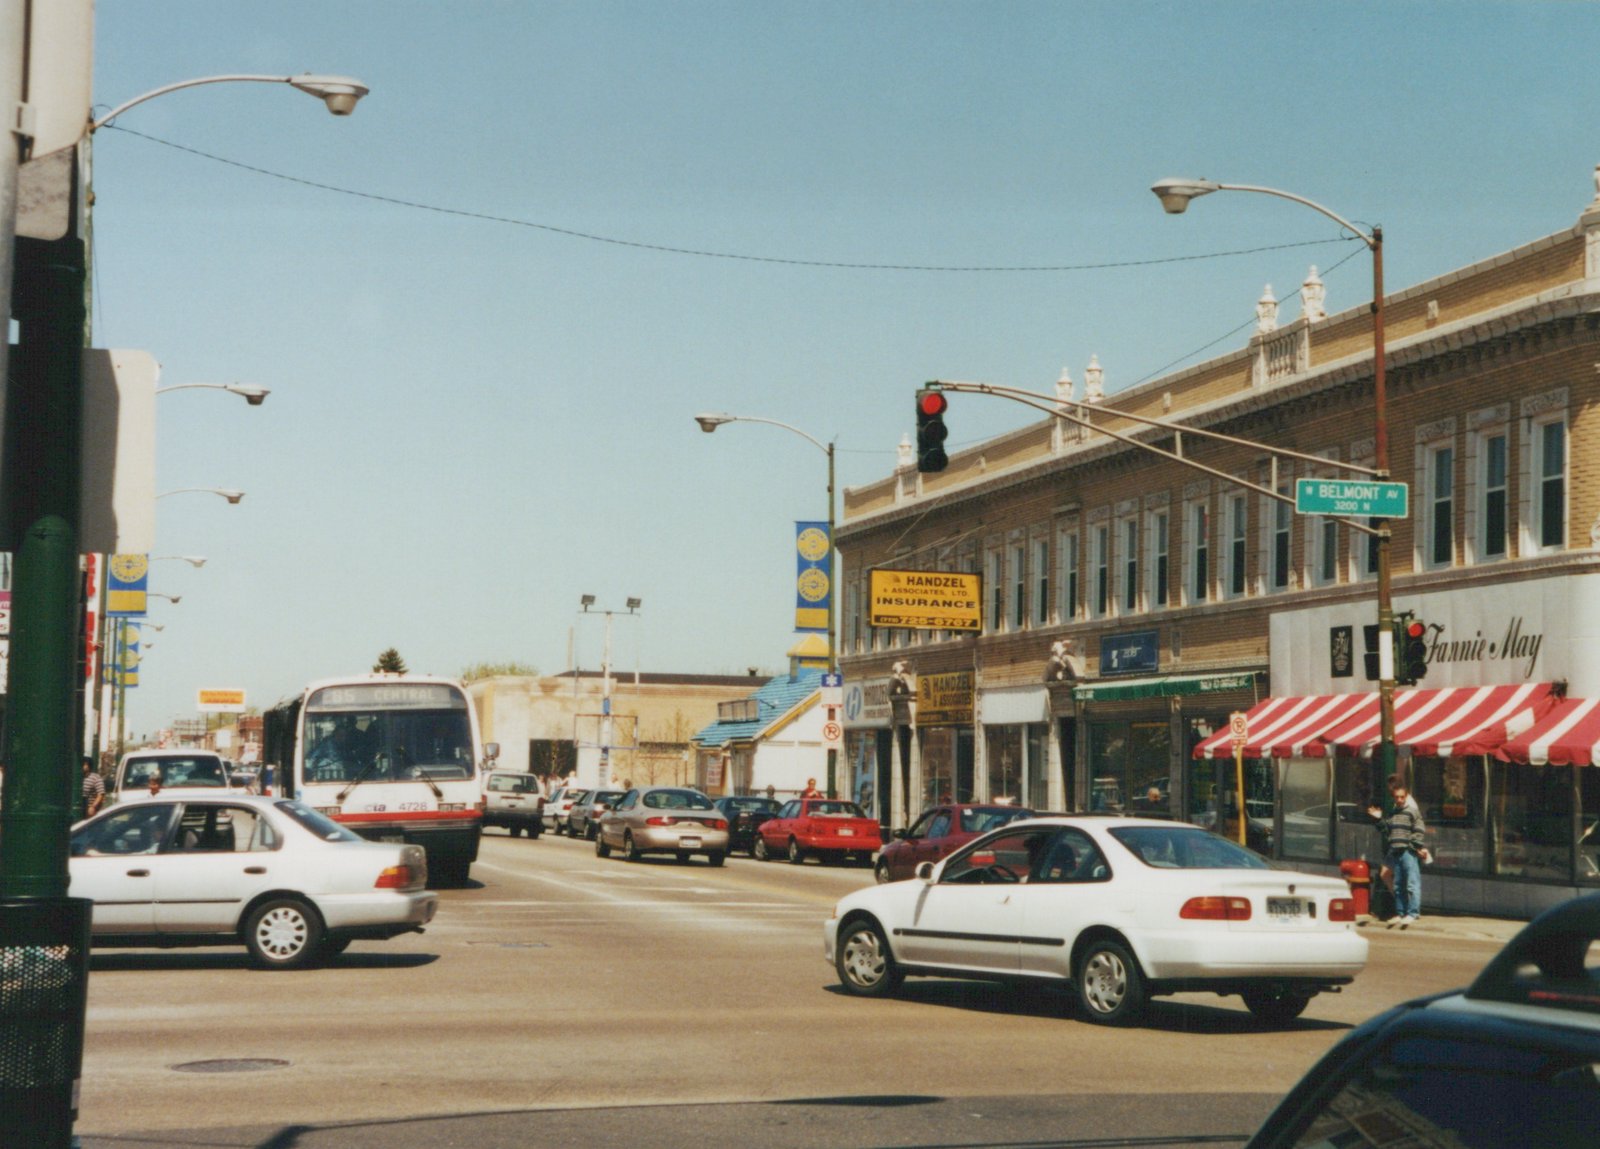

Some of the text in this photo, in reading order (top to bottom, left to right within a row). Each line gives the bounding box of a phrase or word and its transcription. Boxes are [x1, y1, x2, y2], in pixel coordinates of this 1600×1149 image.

[1319, 484, 1379, 500] BELMONT
[1386, 489, 1398, 499] AV
[1334, 501, 1370, 511] 3200 N
[906, 575, 966, 588] HANDZEL
[876, 597, 976, 609] INSURANCE
[1424, 616, 1543, 679] Fannie May
[374, 688, 435, 701] CENTRAL
[398, 802, 427, 811] 4728
